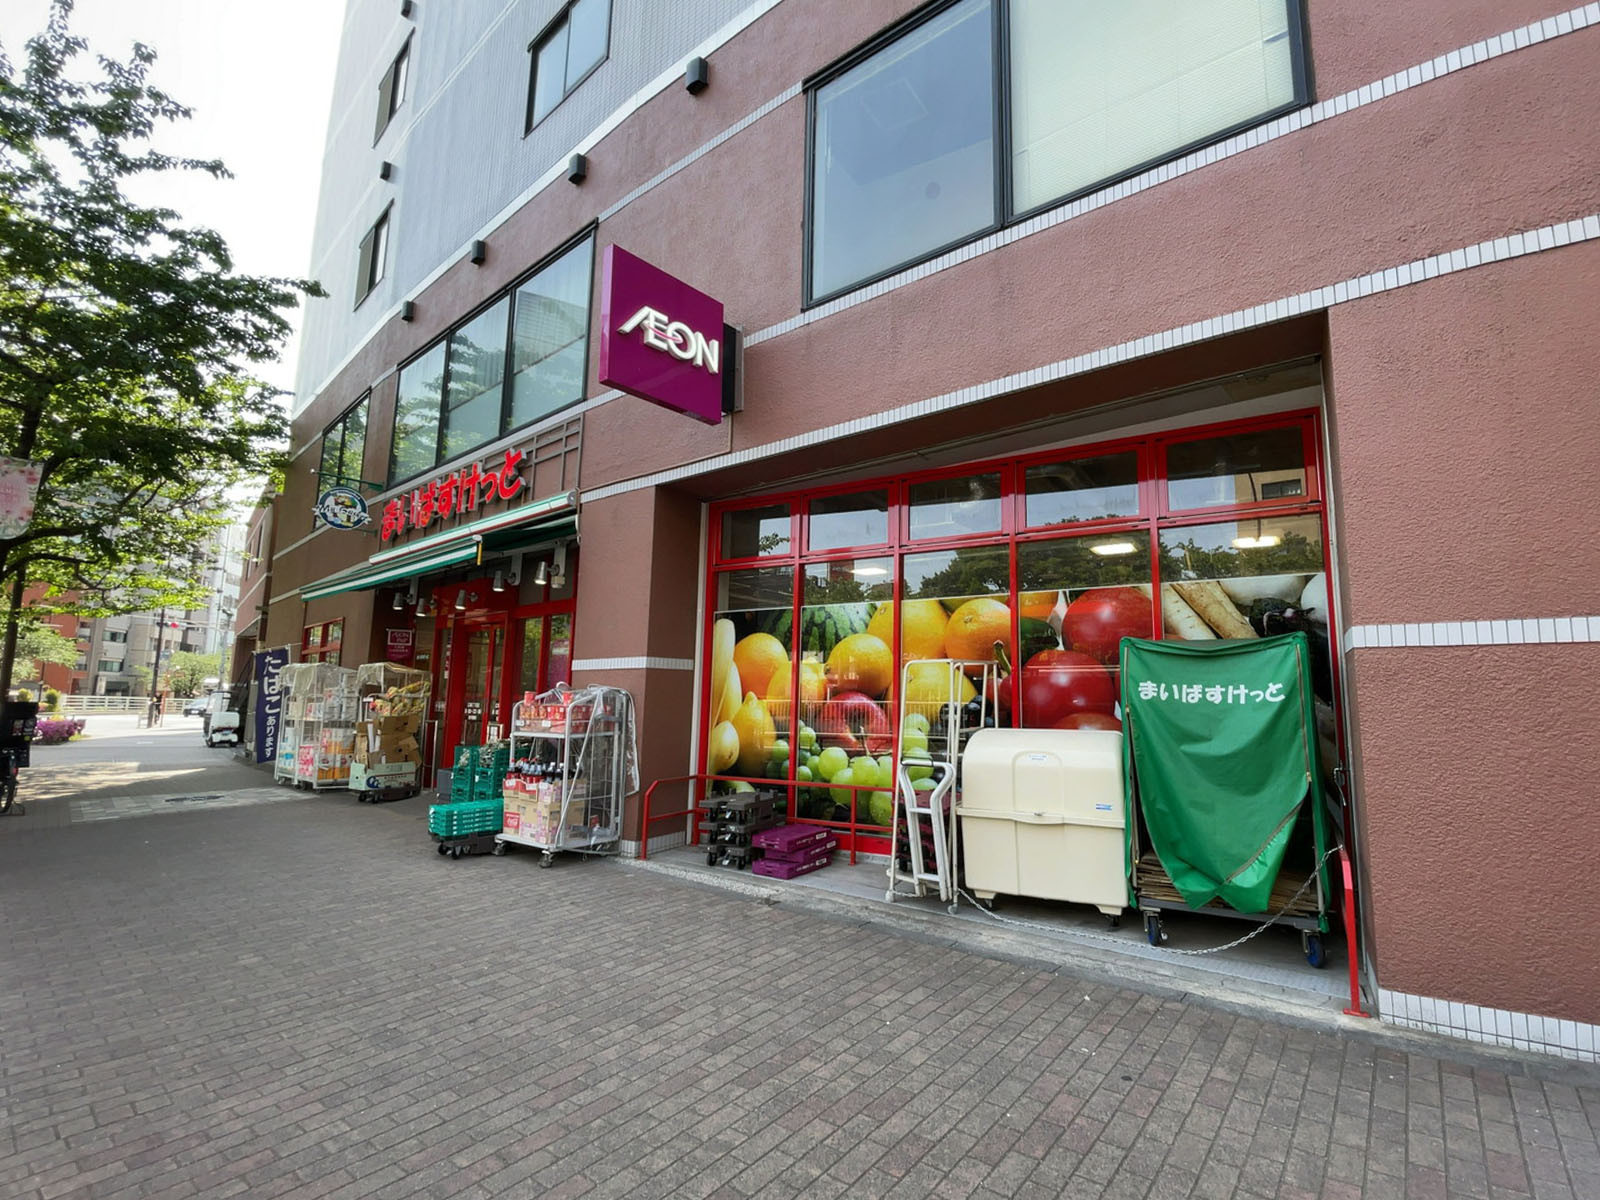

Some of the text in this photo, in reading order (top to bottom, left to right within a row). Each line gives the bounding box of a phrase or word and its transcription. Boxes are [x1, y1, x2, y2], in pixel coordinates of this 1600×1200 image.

[381, 449, 525, 541] まいばすけっと
[1138, 681, 1286, 704] まいばすけっと
